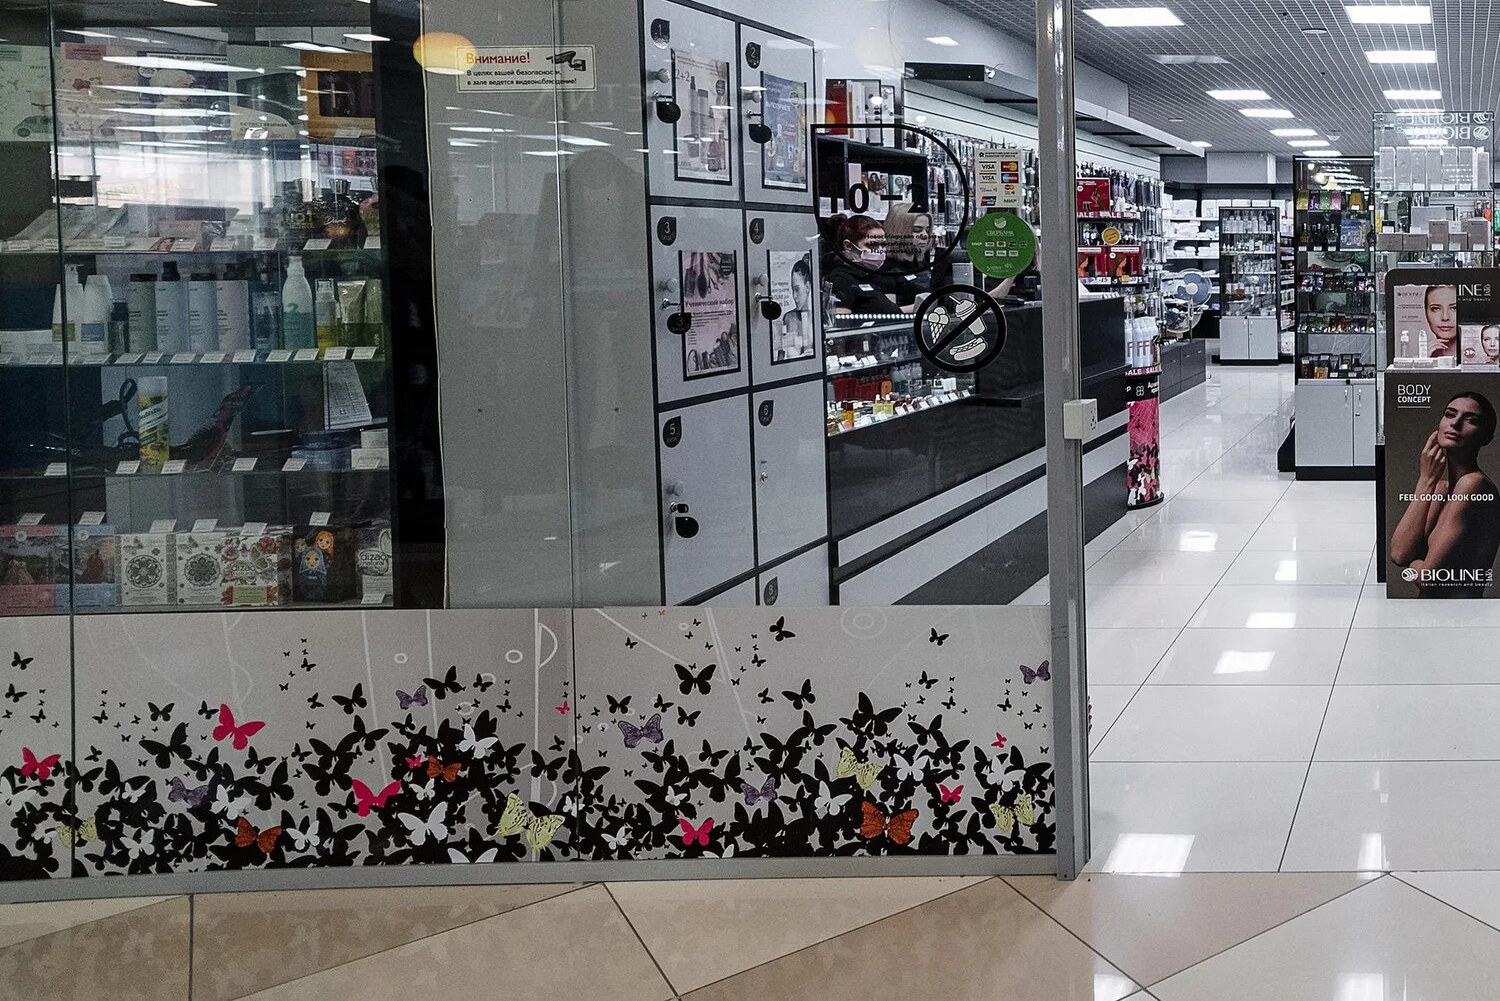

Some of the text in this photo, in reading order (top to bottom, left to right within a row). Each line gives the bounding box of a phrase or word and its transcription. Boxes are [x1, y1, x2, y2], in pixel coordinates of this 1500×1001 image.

[465, 51, 531, 65] Внимание!
[516, 68, 563, 77] безопасноси,
[1457, 283, 1483, 297] INE
[1397, 384, 1432, 396] BODY
[1397, 395, 1432, 403] CONCEPT
[1399, 493, 1494, 502] FEEL GOOD, LOOK GOOD
[1420, 568, 1484, 582] BIOLINE
